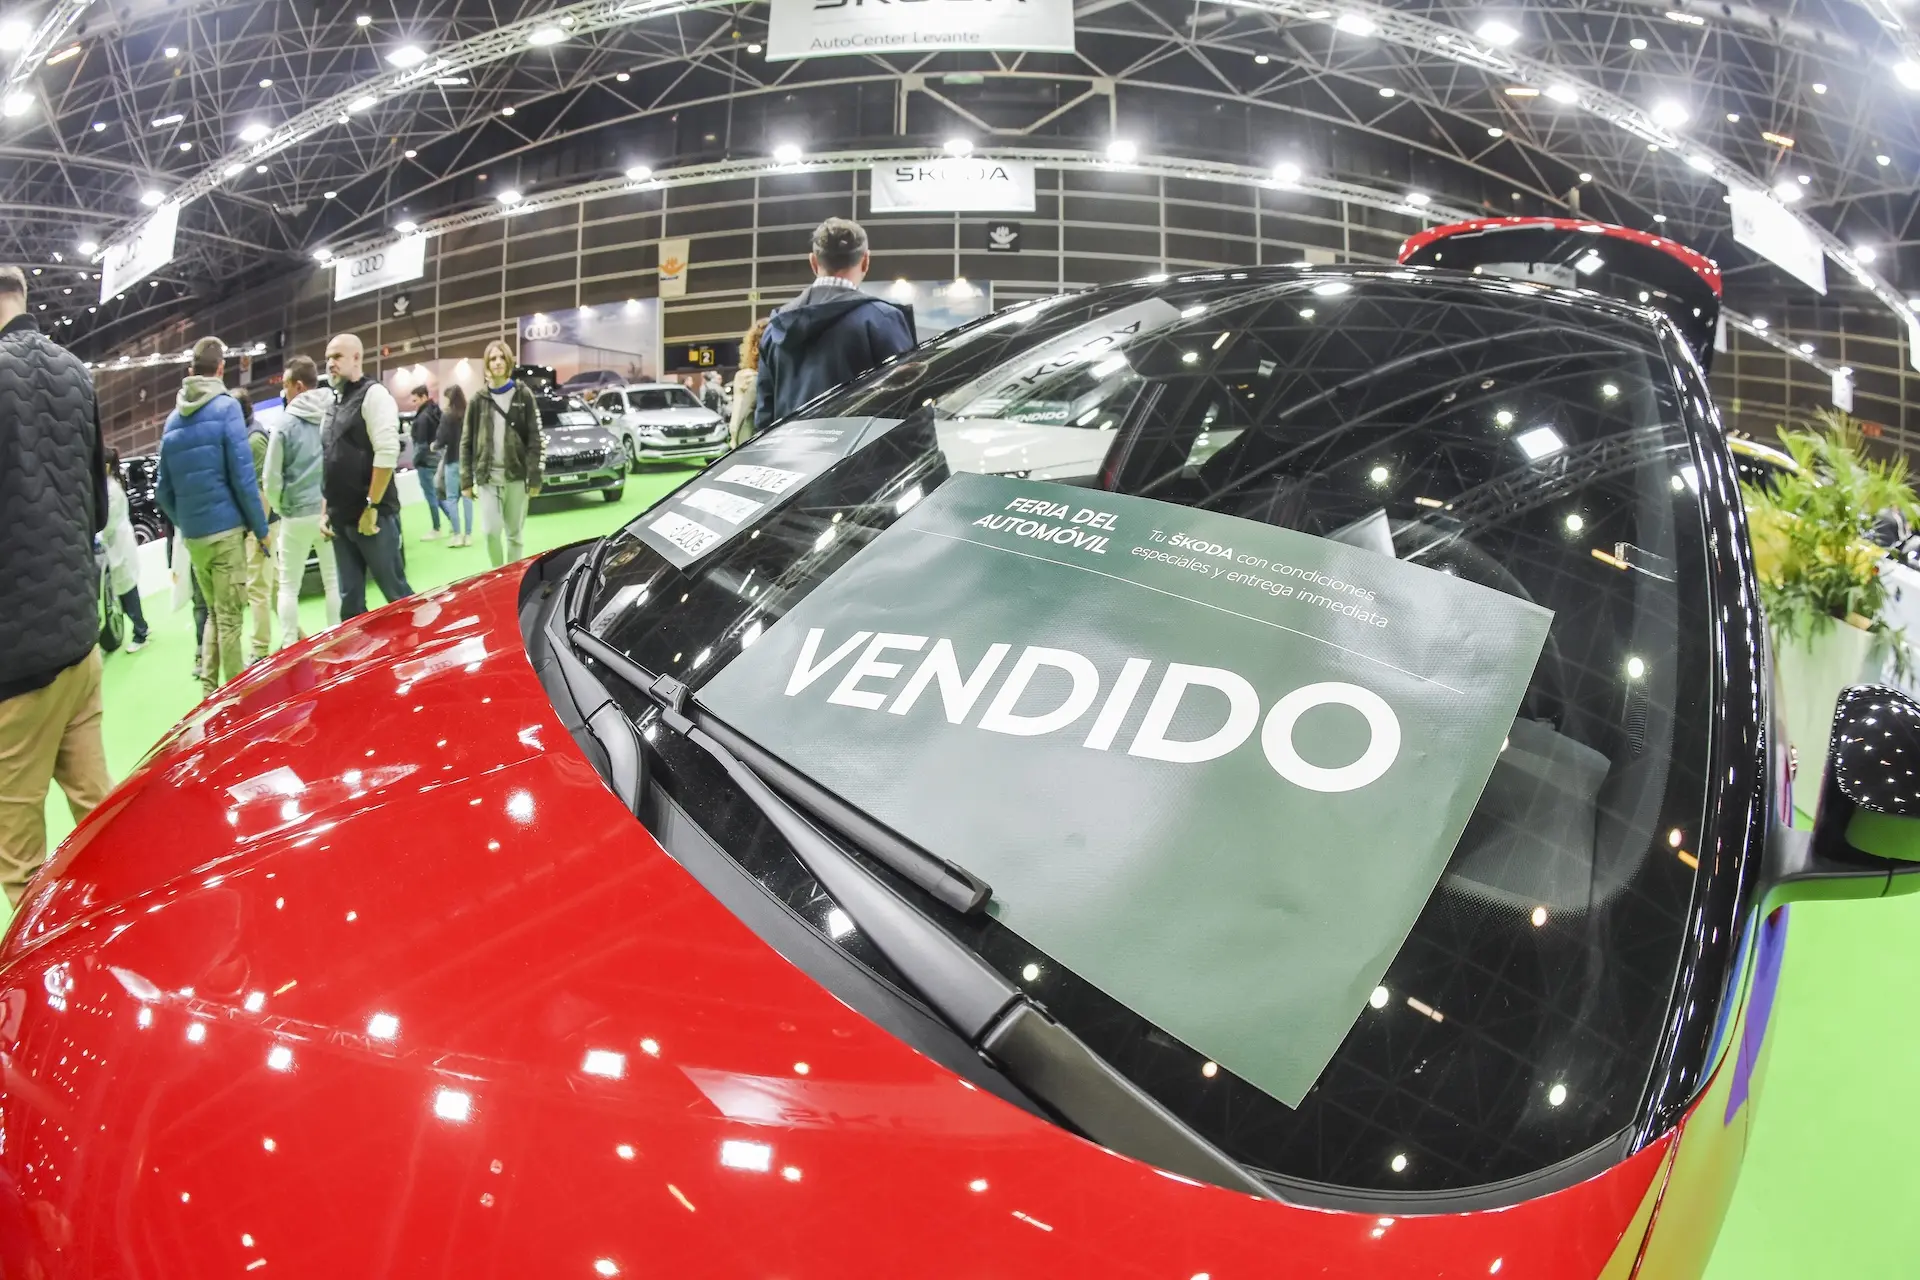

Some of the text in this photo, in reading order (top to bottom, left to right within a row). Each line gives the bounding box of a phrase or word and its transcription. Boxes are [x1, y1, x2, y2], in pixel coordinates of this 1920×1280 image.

[810, 31, 980, 50] AutoCenter Levante
[702, 352, 711, 364] 2
[972, 514, 1107, 554] AUTOMÓVIL
[1004, 497, 1117, 532] FERIA DEL
[1148, 529, 1377, 602] Tu ŠKODA con condiciones
[1131, 545, 1390, 629] especiales y entrega inmediata
[784, 627, 1402, 793] VENDIDO
